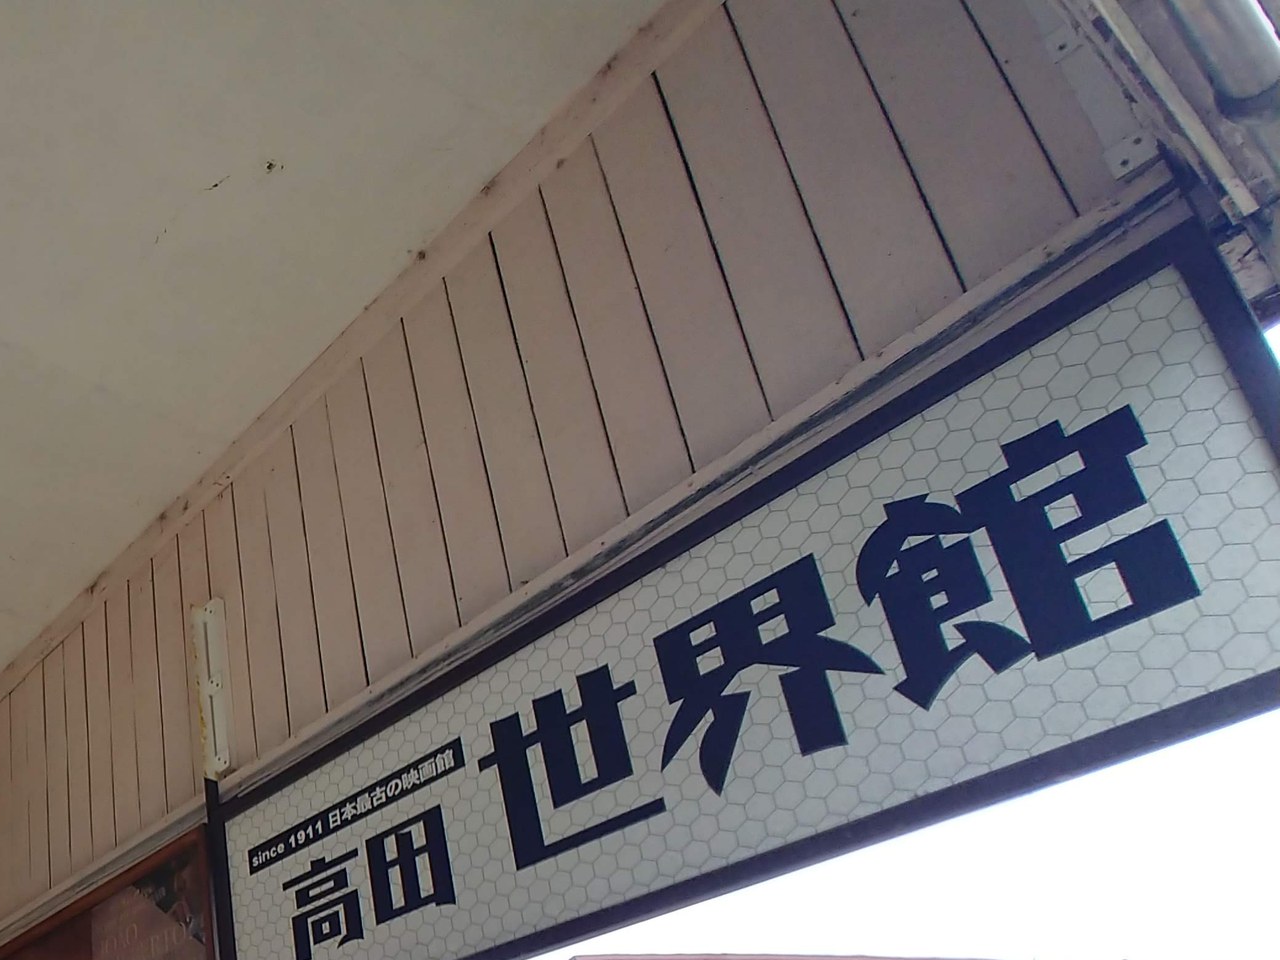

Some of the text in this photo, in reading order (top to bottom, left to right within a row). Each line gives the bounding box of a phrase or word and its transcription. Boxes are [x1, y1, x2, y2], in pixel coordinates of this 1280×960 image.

[251, 749, 455, 867] since 1911 日本最古の映画館
